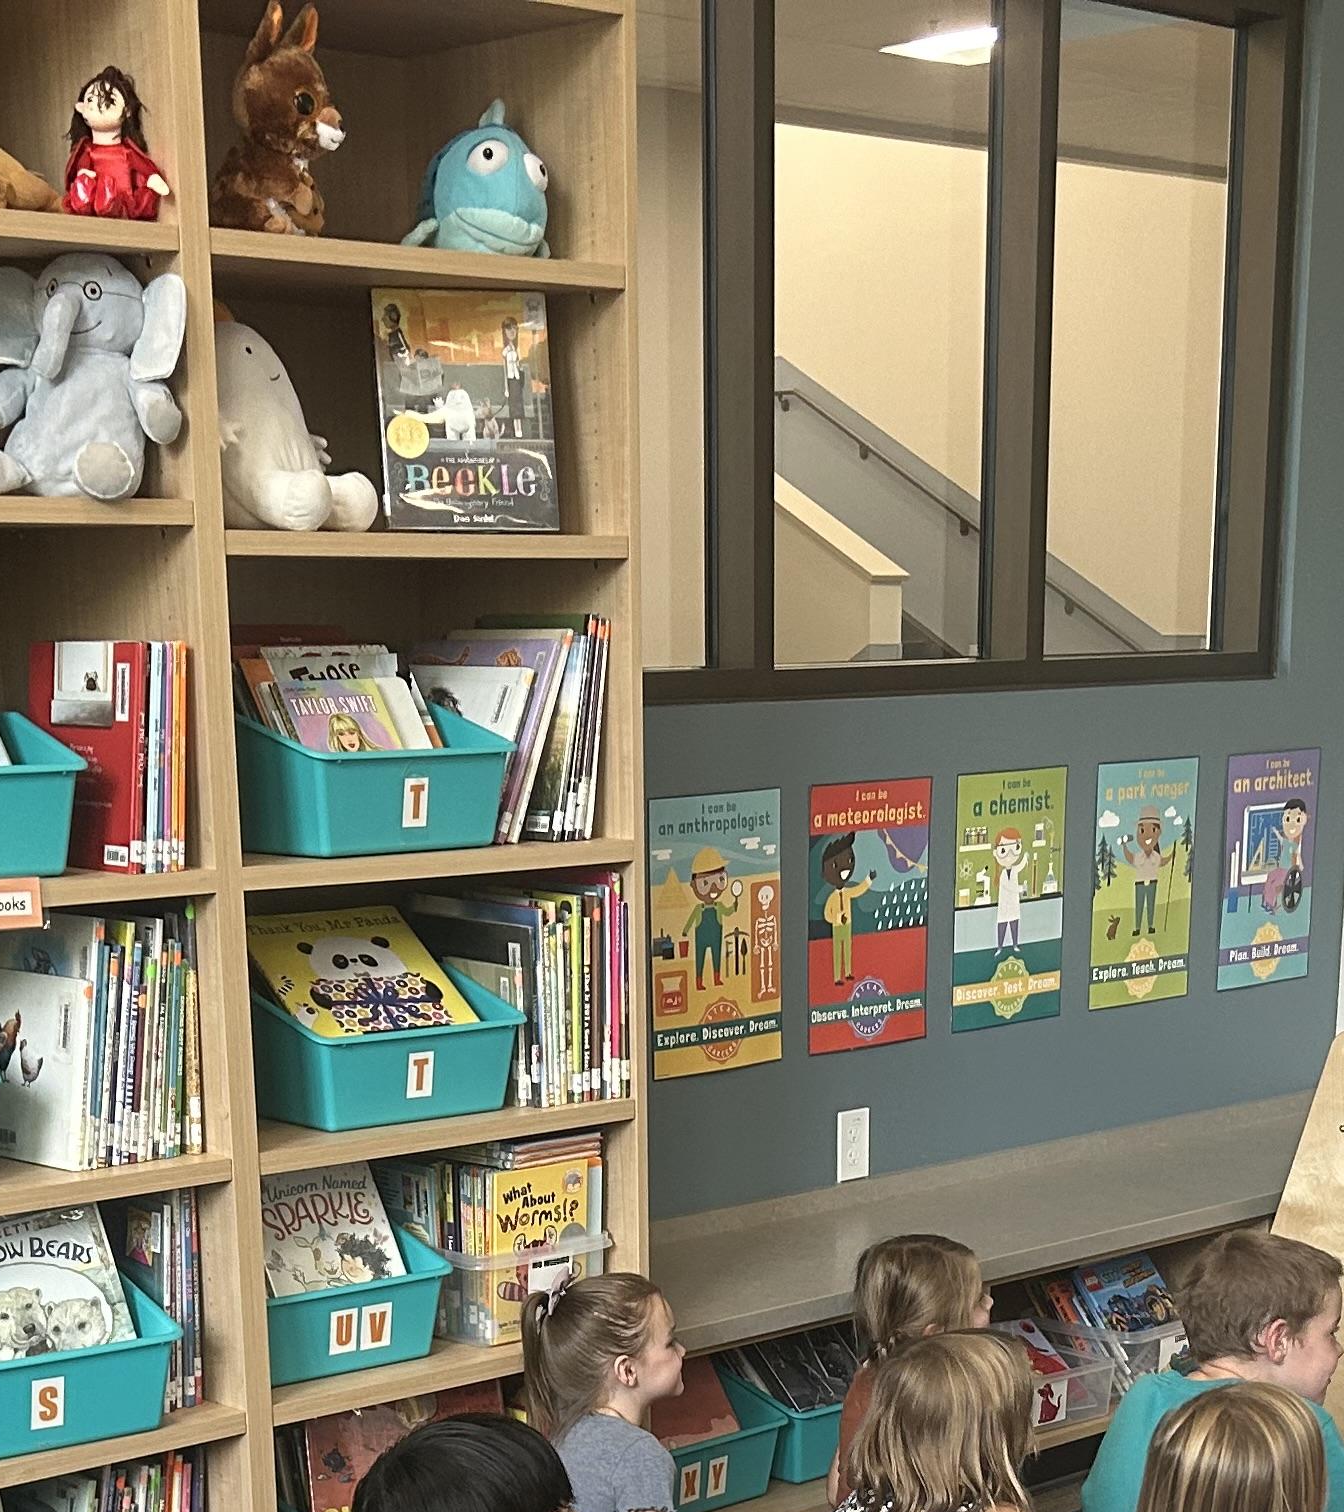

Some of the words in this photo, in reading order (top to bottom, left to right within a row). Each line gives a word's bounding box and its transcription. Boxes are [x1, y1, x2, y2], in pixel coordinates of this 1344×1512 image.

[290, 697, 337, 716] TAYLOR
[339, 695, 377, 714] SWIFT
[861, 790, 876, 801] can
[878, 789, 887, 800] be
[1007, 780, 1020, 790] can
[1022, 778, 1031, 788] be
[1106, 787, 1112, 800] a
[1118, 783, 1146, 804] park
[1233, 778, 1250, 792] an
[1255, 772, 1313, 792] architect.
[410, 784, 425, 819] T
[708, 804, 724, 814] can
[726, 801, 736, 812] be
[973, 801, 982, 817] a
[990, 790, 1054, 815] chemist.
[659, 821, 674, 836] an
[678, 811, 774, 834] anthropologist.
[814, 814, 822, 828] a
[827, 804, 926, 827] meteorologist.
[248, 925, 293, 936] Thank
[355, 915, 401, 928] Panda
[1092, 966, 1129, 982] Explore.
[1158, 958, 1186, 971] Dream.
[811, 1009, 849, 1024] Observe.
[851, 1003, 895, 1020] Interpret.
[896, 997, 923, 1010] Dream.
[657, 1029, 699, 1048] Explore.
[702, 1025, 747, 1040] Discover.
[749, 1018, 779, 1034] Dream.
[413, 1058, 429, 1090] T
[267, 1180, 316, 1203] Unicorn
[322, 1175, 367, 1191] Named
[503, 1182, 532, 1205] What
[522, 1192, 556, 1208] About
[262, 1192, 374, 1241] SPARKLE
[497, 1198, 579, 1233] Worms!?
[29, 1237, 94, 1264] BEARS
[336, 1313, 353, 1347] U
[369, 1310, 387, 1343] V
[39, 1386, 58, 1421] S
[684, 1469, 698, 1499] X
[712, 1462, 725, 1491] Y
